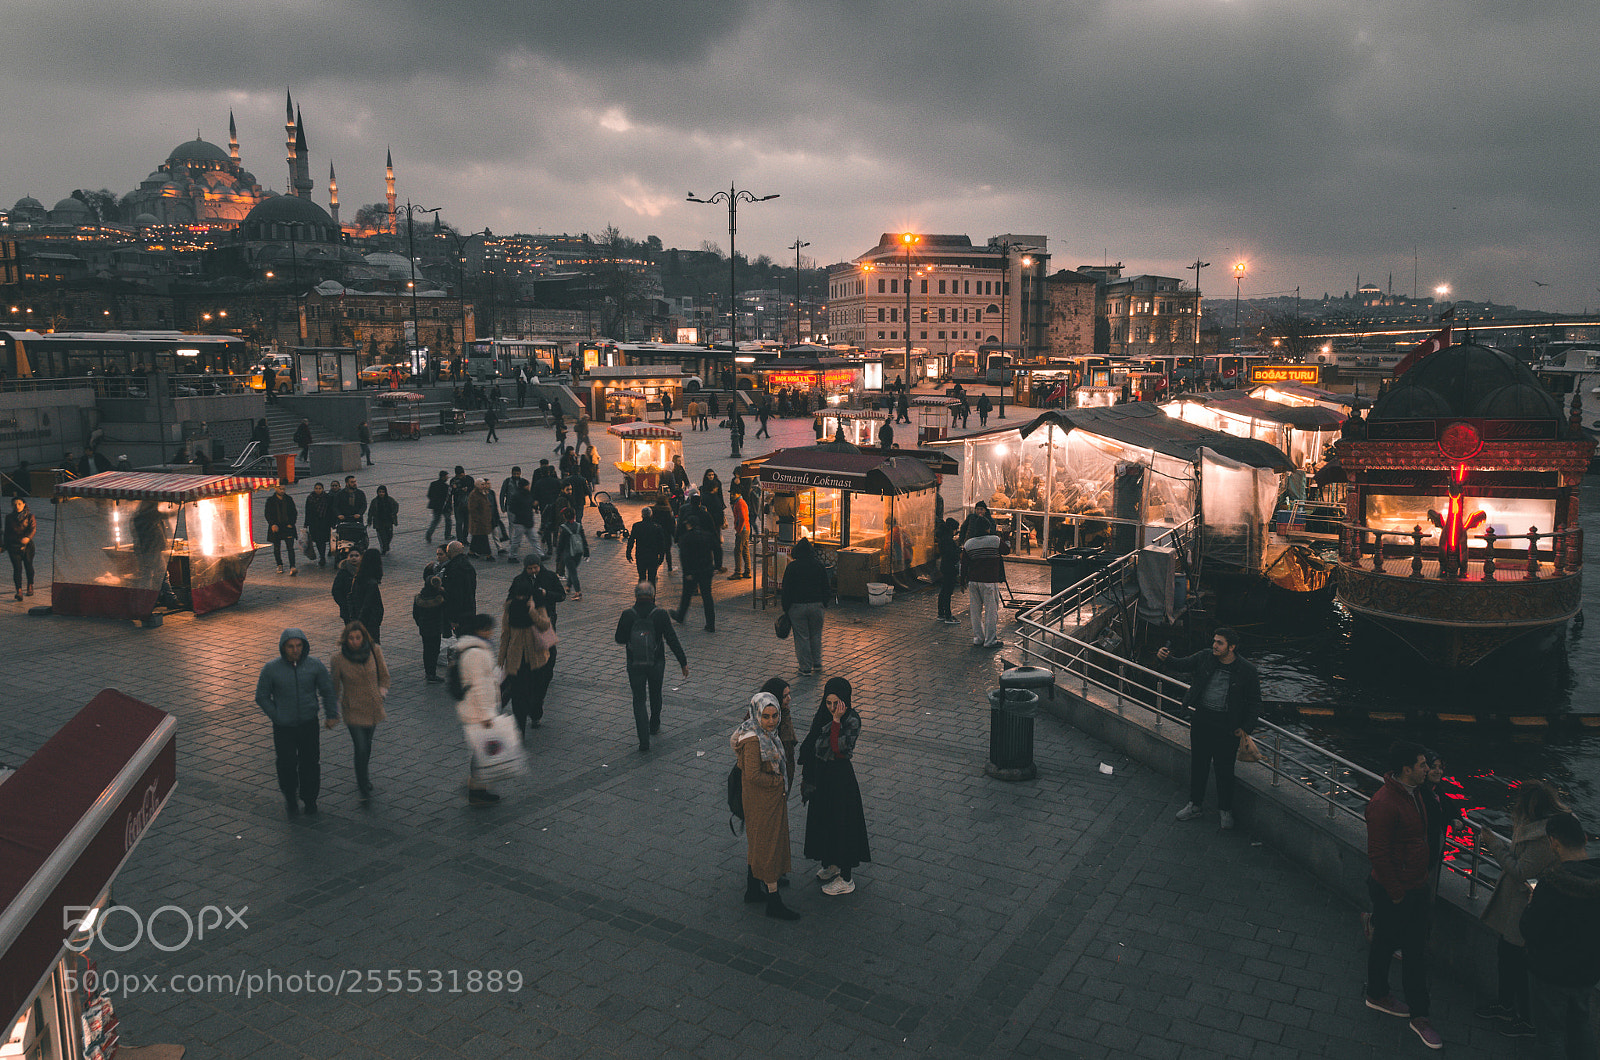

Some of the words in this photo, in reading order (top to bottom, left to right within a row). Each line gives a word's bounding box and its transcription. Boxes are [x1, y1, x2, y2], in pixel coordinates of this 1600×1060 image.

[1255, 369, 1287, 380] BOĞAZ
[1288, 371, 1314, 380] TURU
[772, 471, 809, 484] Osmanlı
[812, 475, 852, 488] Lokması
